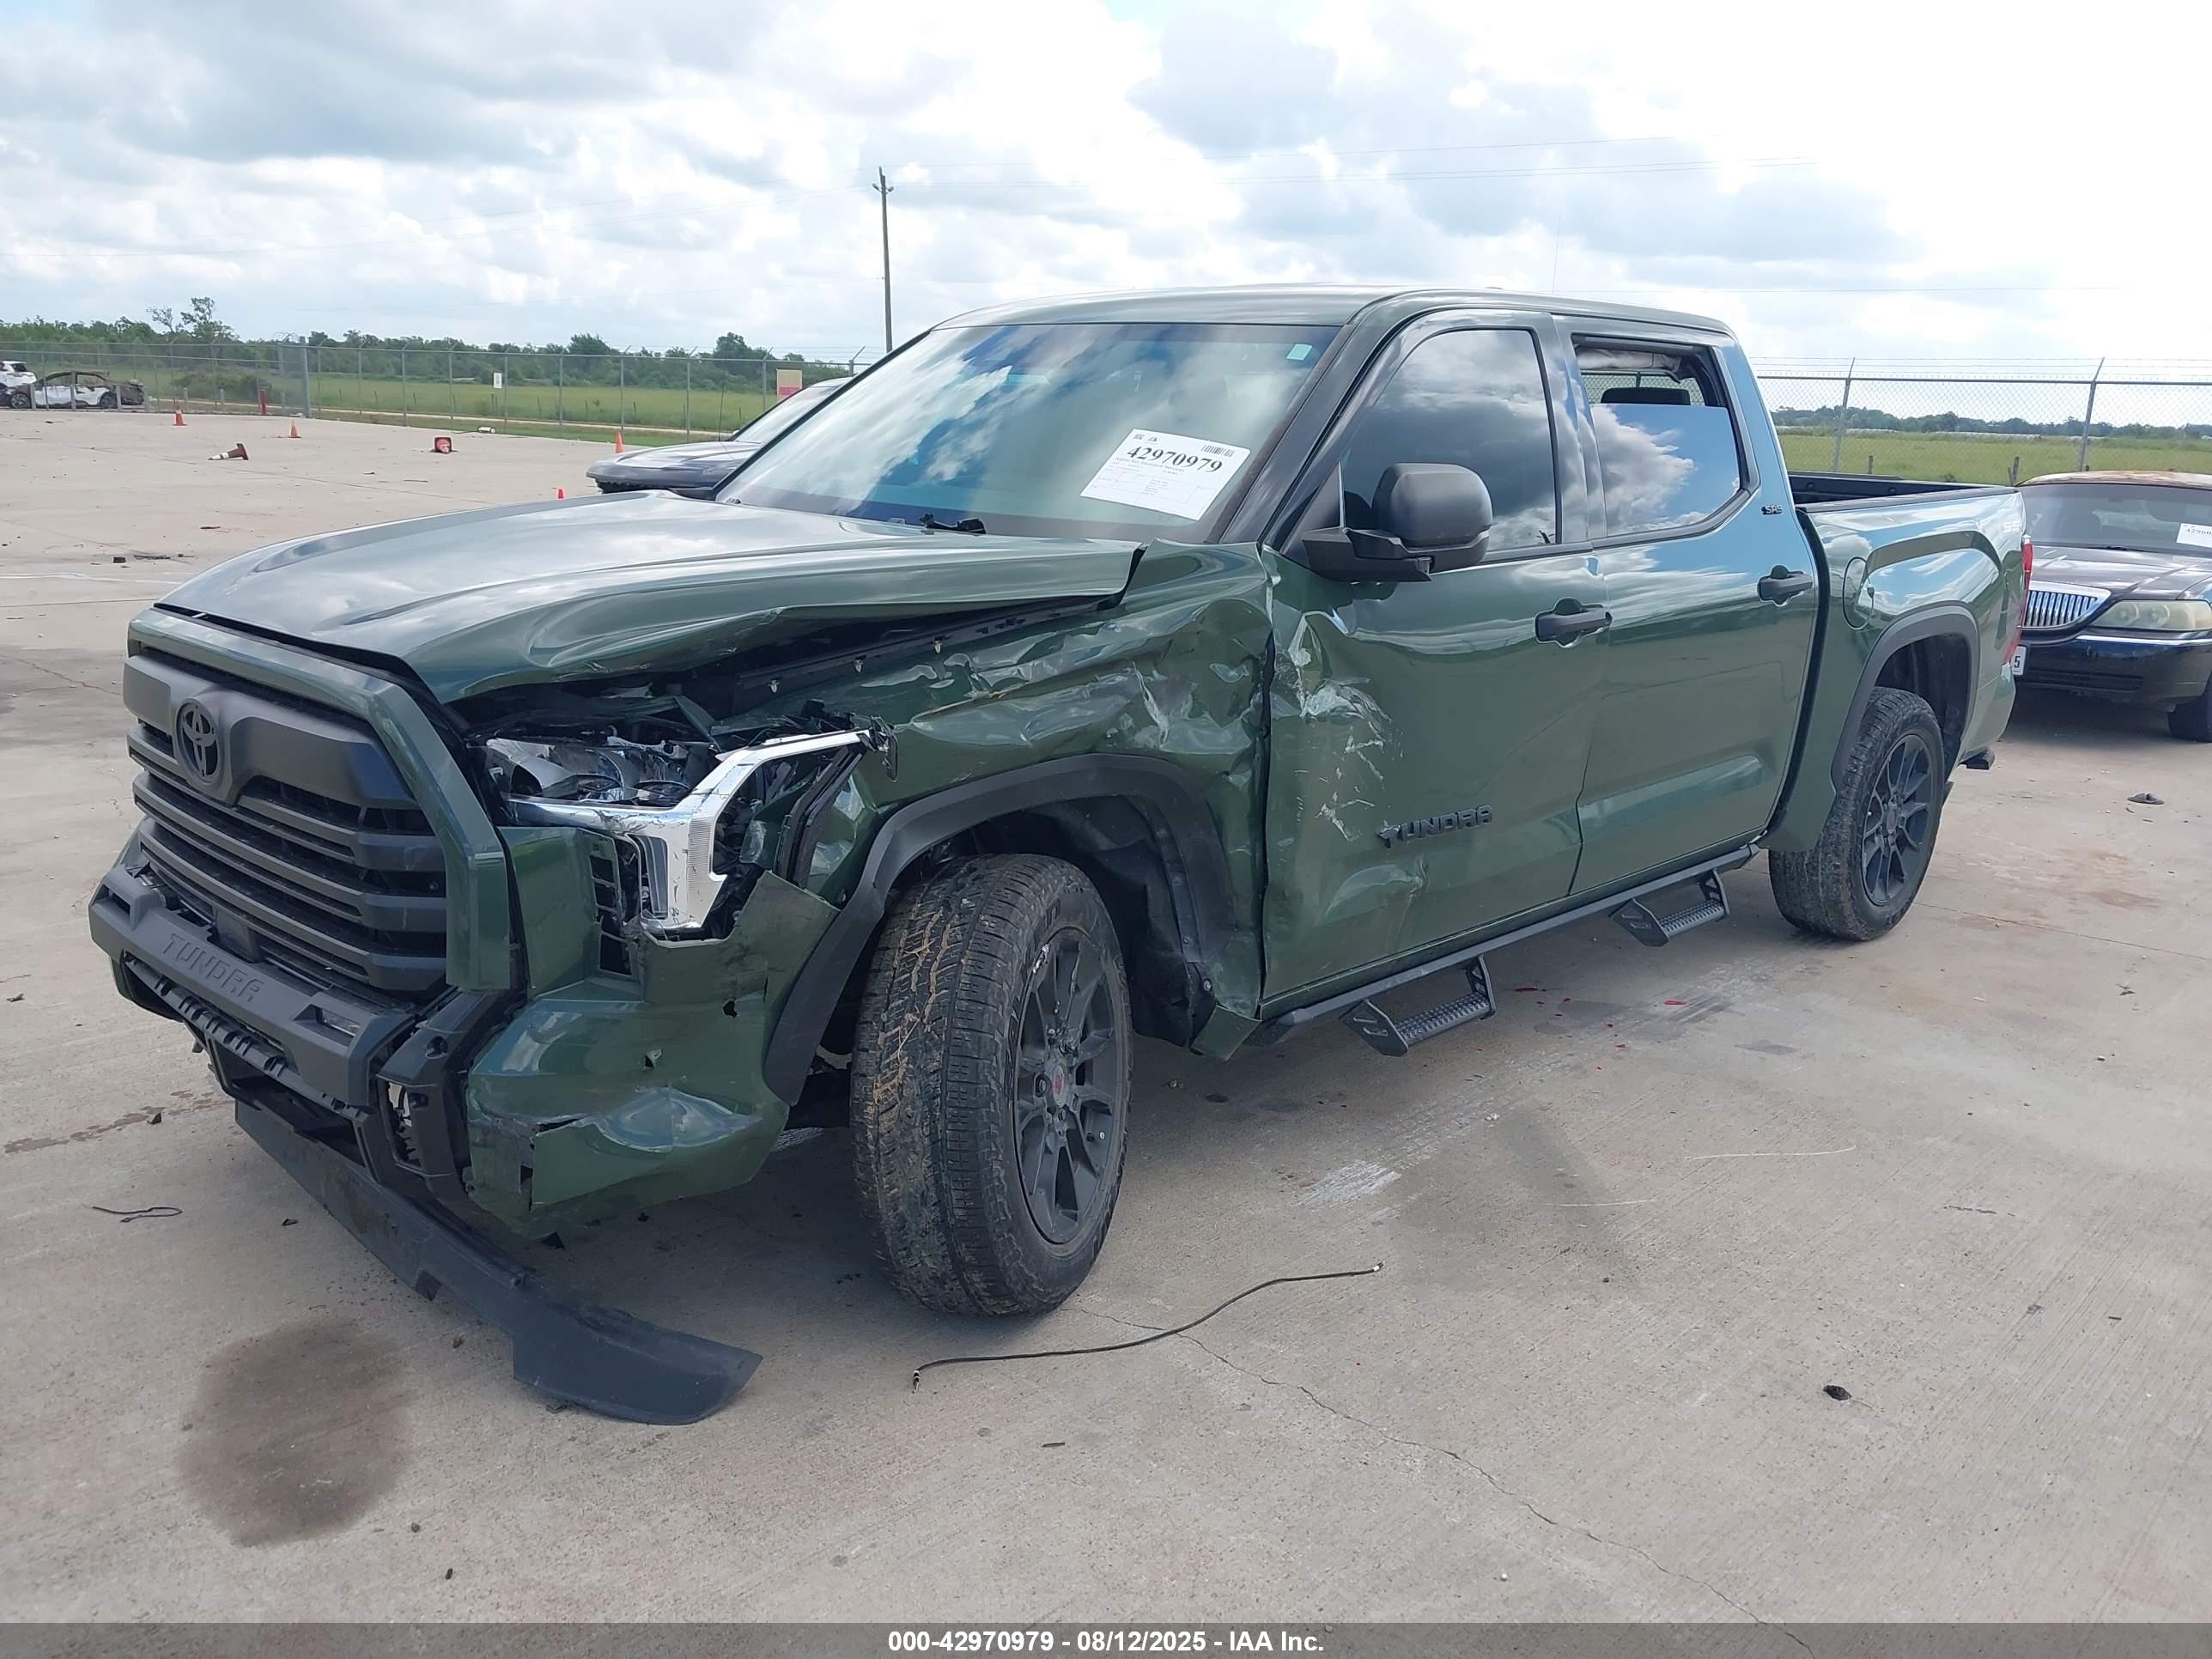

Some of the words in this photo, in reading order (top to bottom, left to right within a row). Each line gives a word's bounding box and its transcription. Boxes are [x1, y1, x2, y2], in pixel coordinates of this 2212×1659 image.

[1127, 446, 1223, 473] 42970979
[1376, 805, 1492, 848] TUNDRA
[162, 933, 265, 1002] TUNDRA
